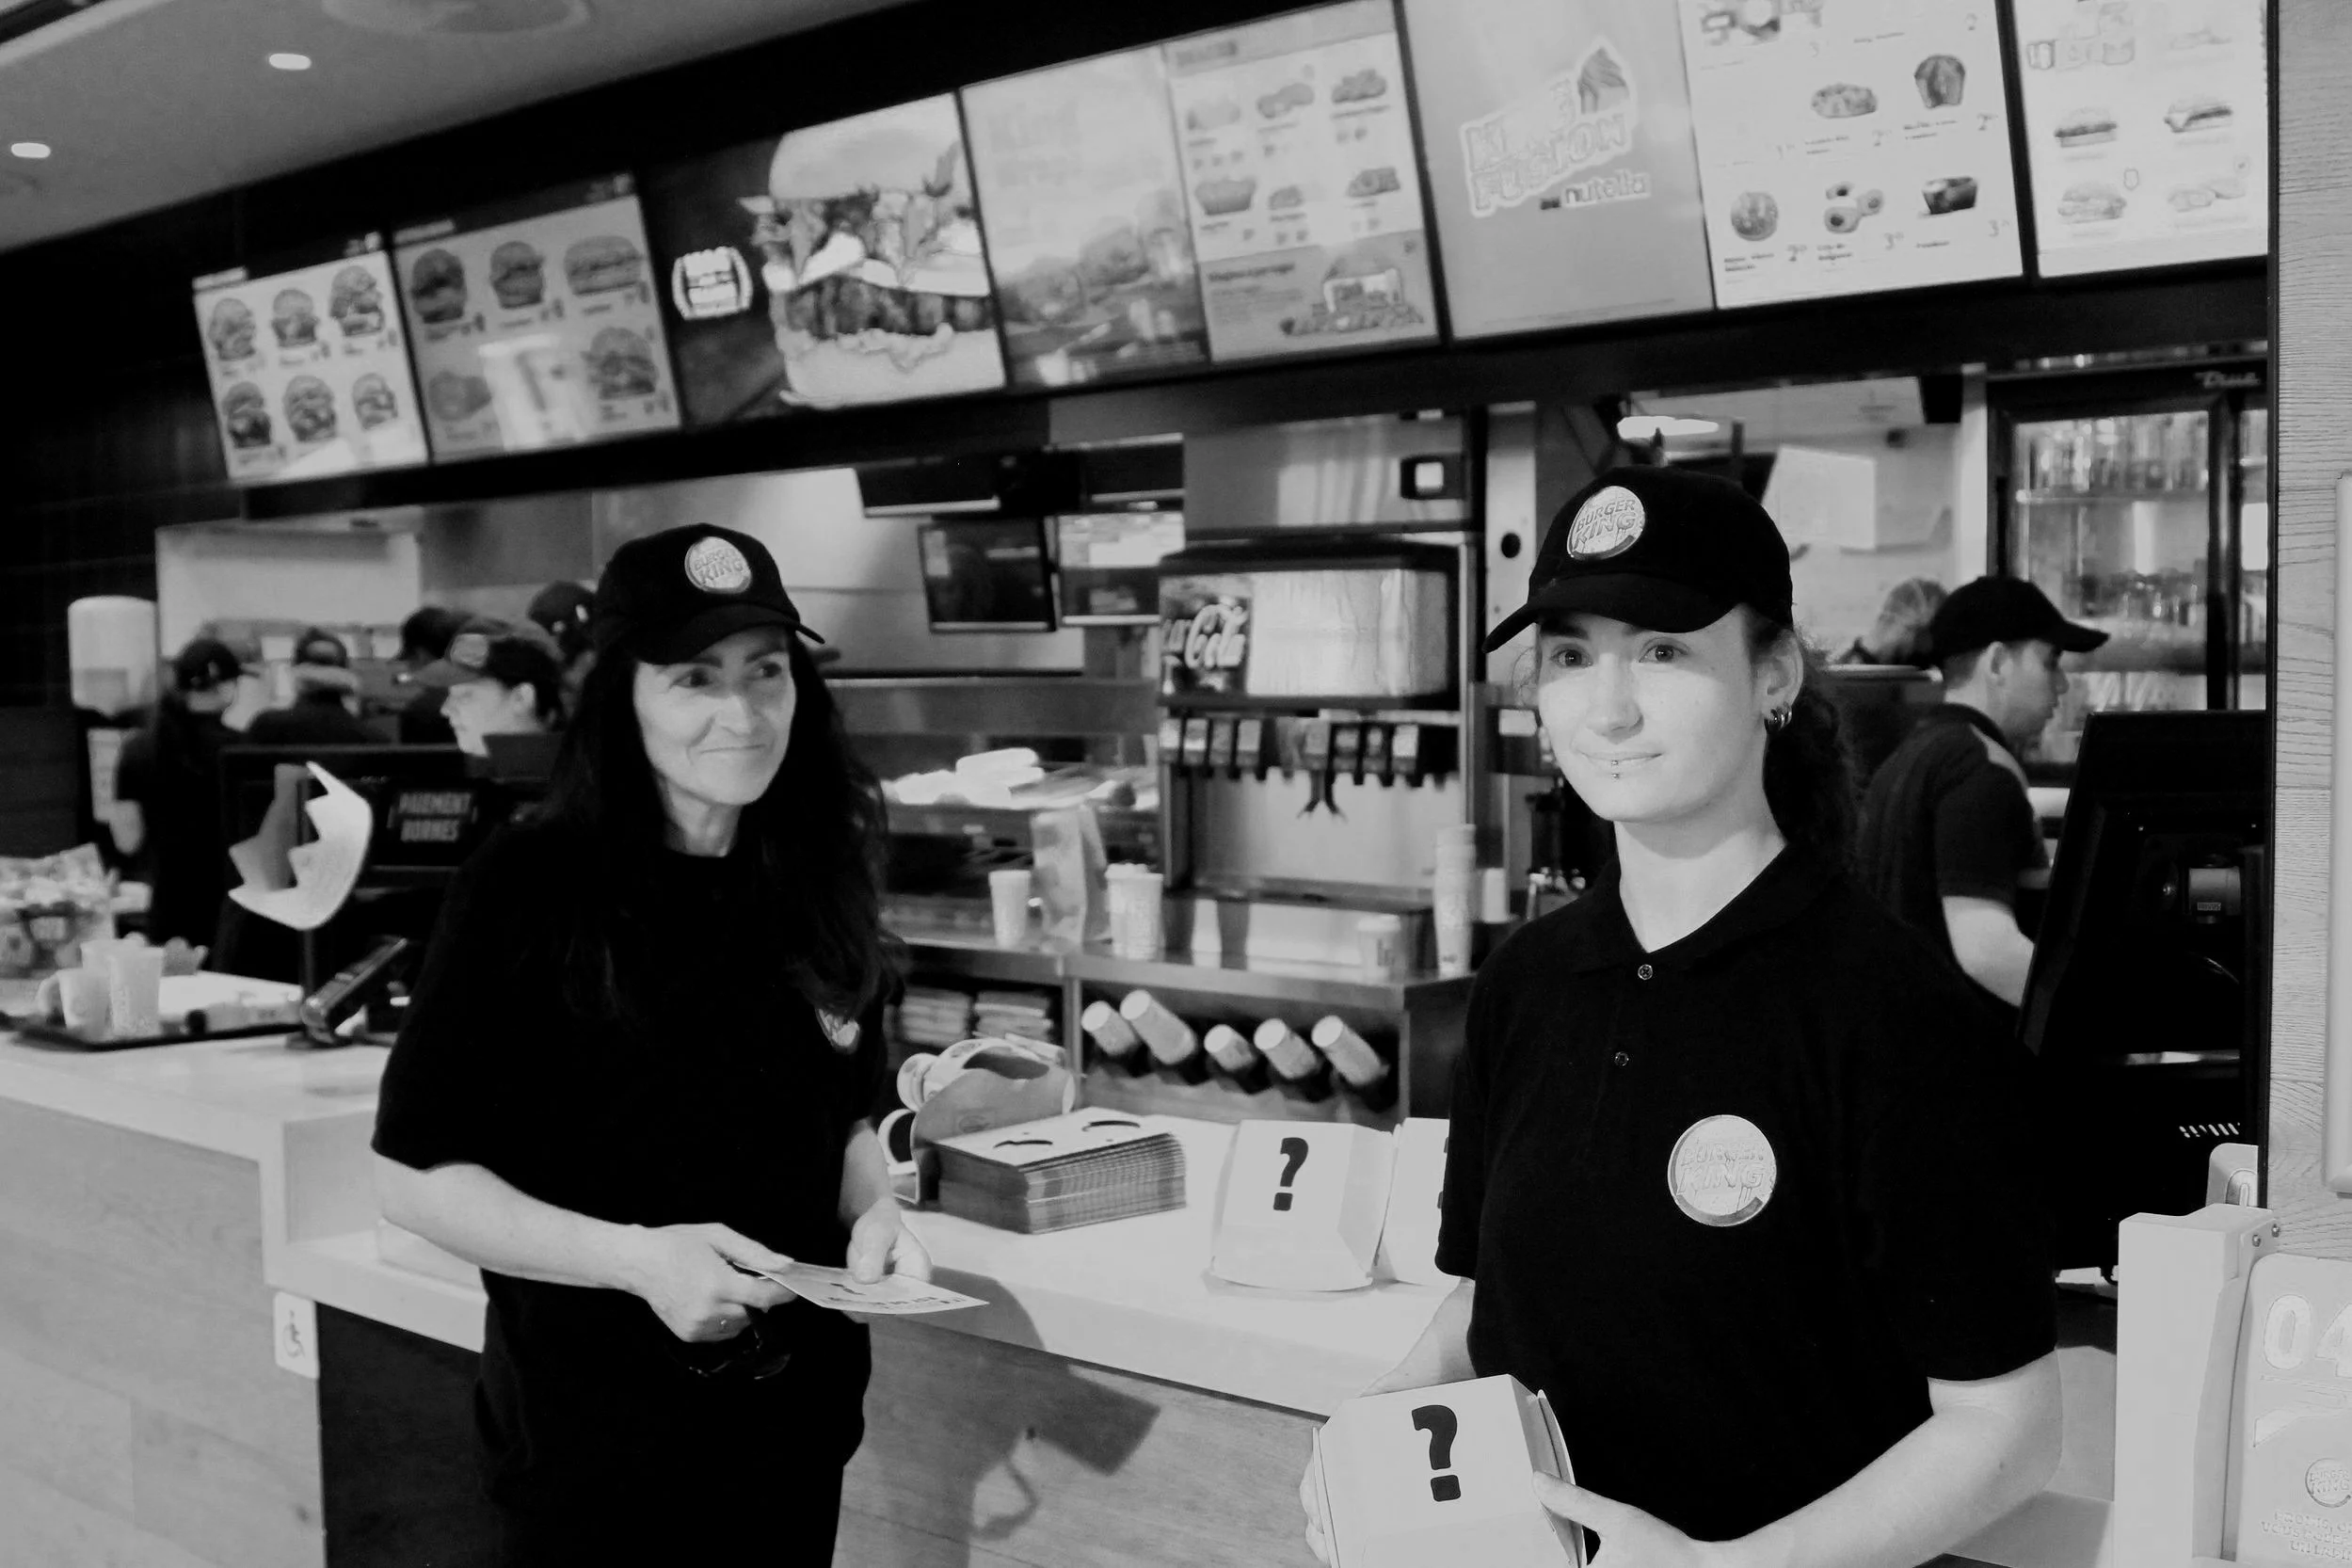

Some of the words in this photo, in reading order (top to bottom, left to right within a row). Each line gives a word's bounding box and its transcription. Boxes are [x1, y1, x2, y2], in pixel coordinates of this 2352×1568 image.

[1564, 168, 1649, 204] nutella
[1573, 514, 1635, 550] KING
[1576, 500, 1635, 533] BURGER
